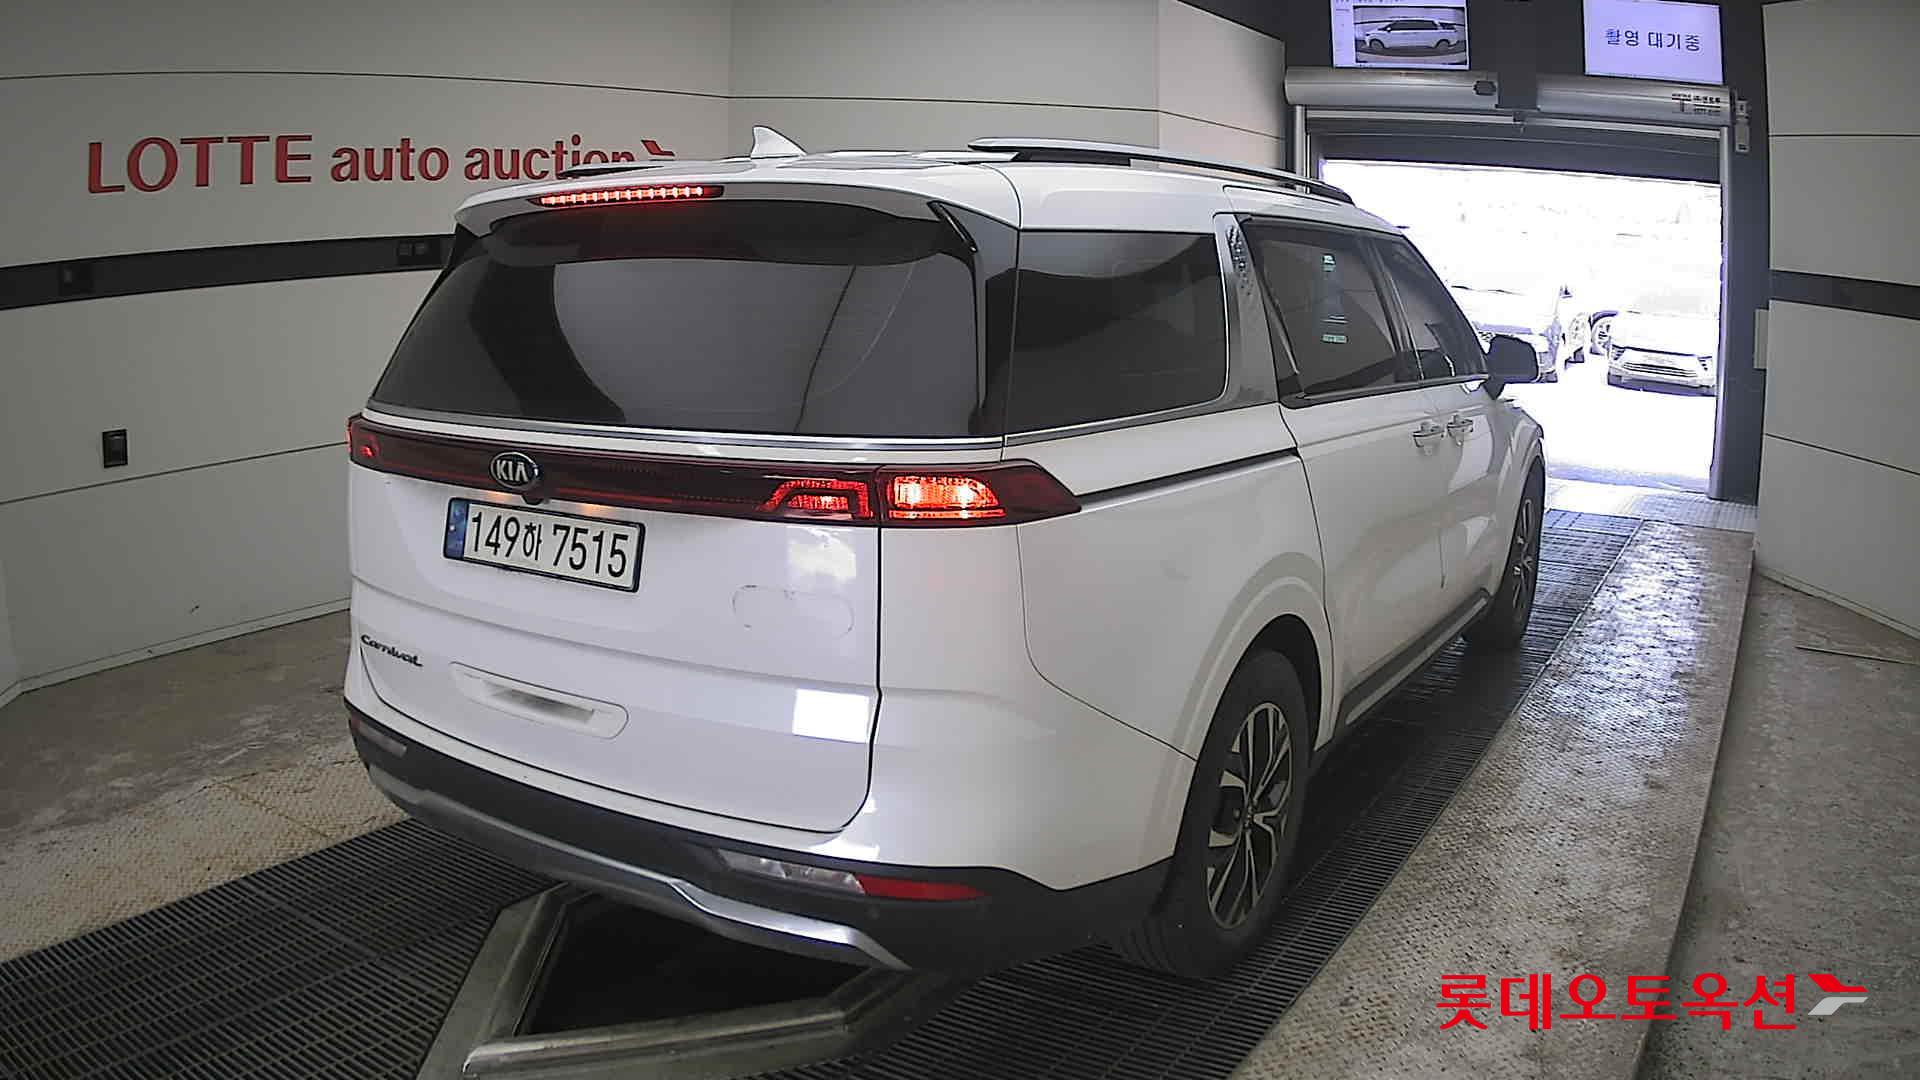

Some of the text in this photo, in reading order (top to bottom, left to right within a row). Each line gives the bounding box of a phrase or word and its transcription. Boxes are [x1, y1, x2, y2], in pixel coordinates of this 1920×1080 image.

[88, 135, 312, 193] LOTTE
[331, 138, 449, 181] auto
[496, 459, 528, 482] KIA
[472, 511, 629, 578] 149하 7515
